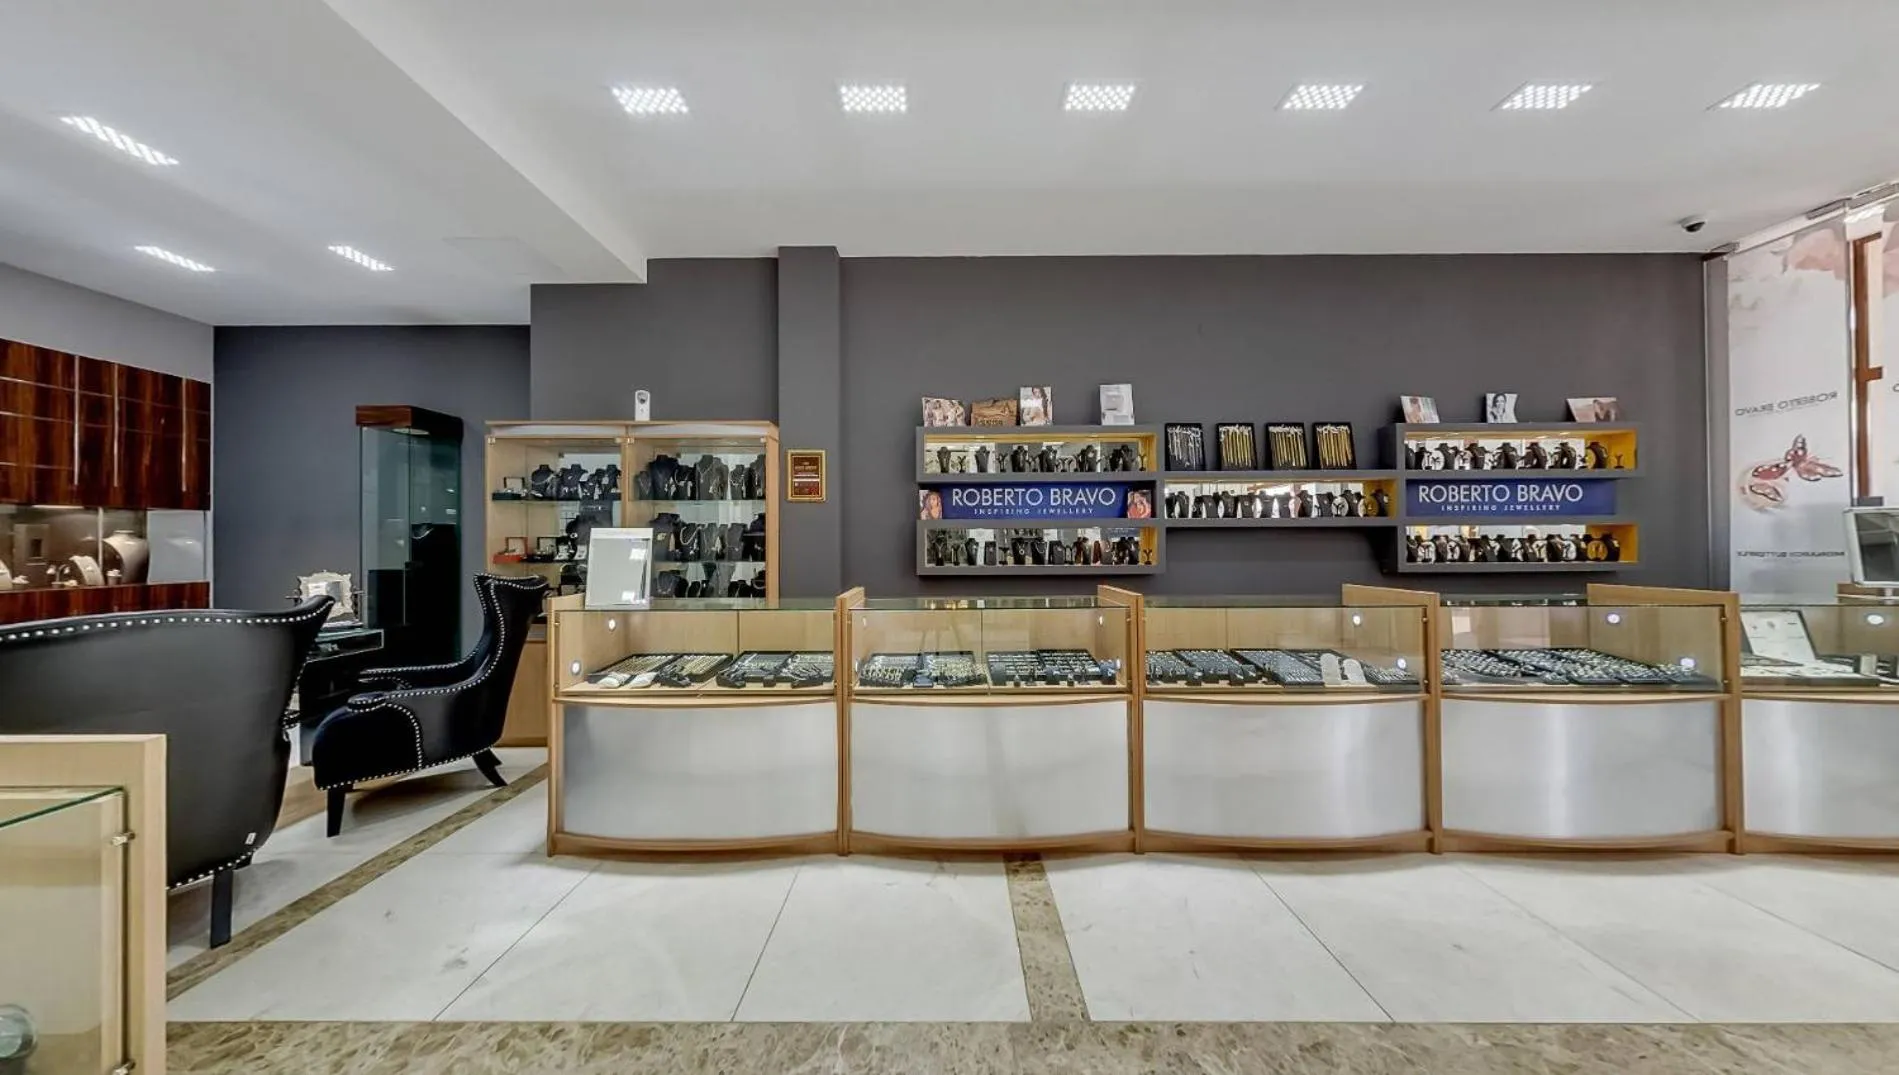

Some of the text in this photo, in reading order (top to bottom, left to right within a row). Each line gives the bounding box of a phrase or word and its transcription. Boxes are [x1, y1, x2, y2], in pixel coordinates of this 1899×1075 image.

[952, 487, 1116, 506] ROBERTO BRAVO
[1418, 484, 1583, 503] ROBERTO BRAVO
[1038, 507, 1093, 515] JEWELLERY
